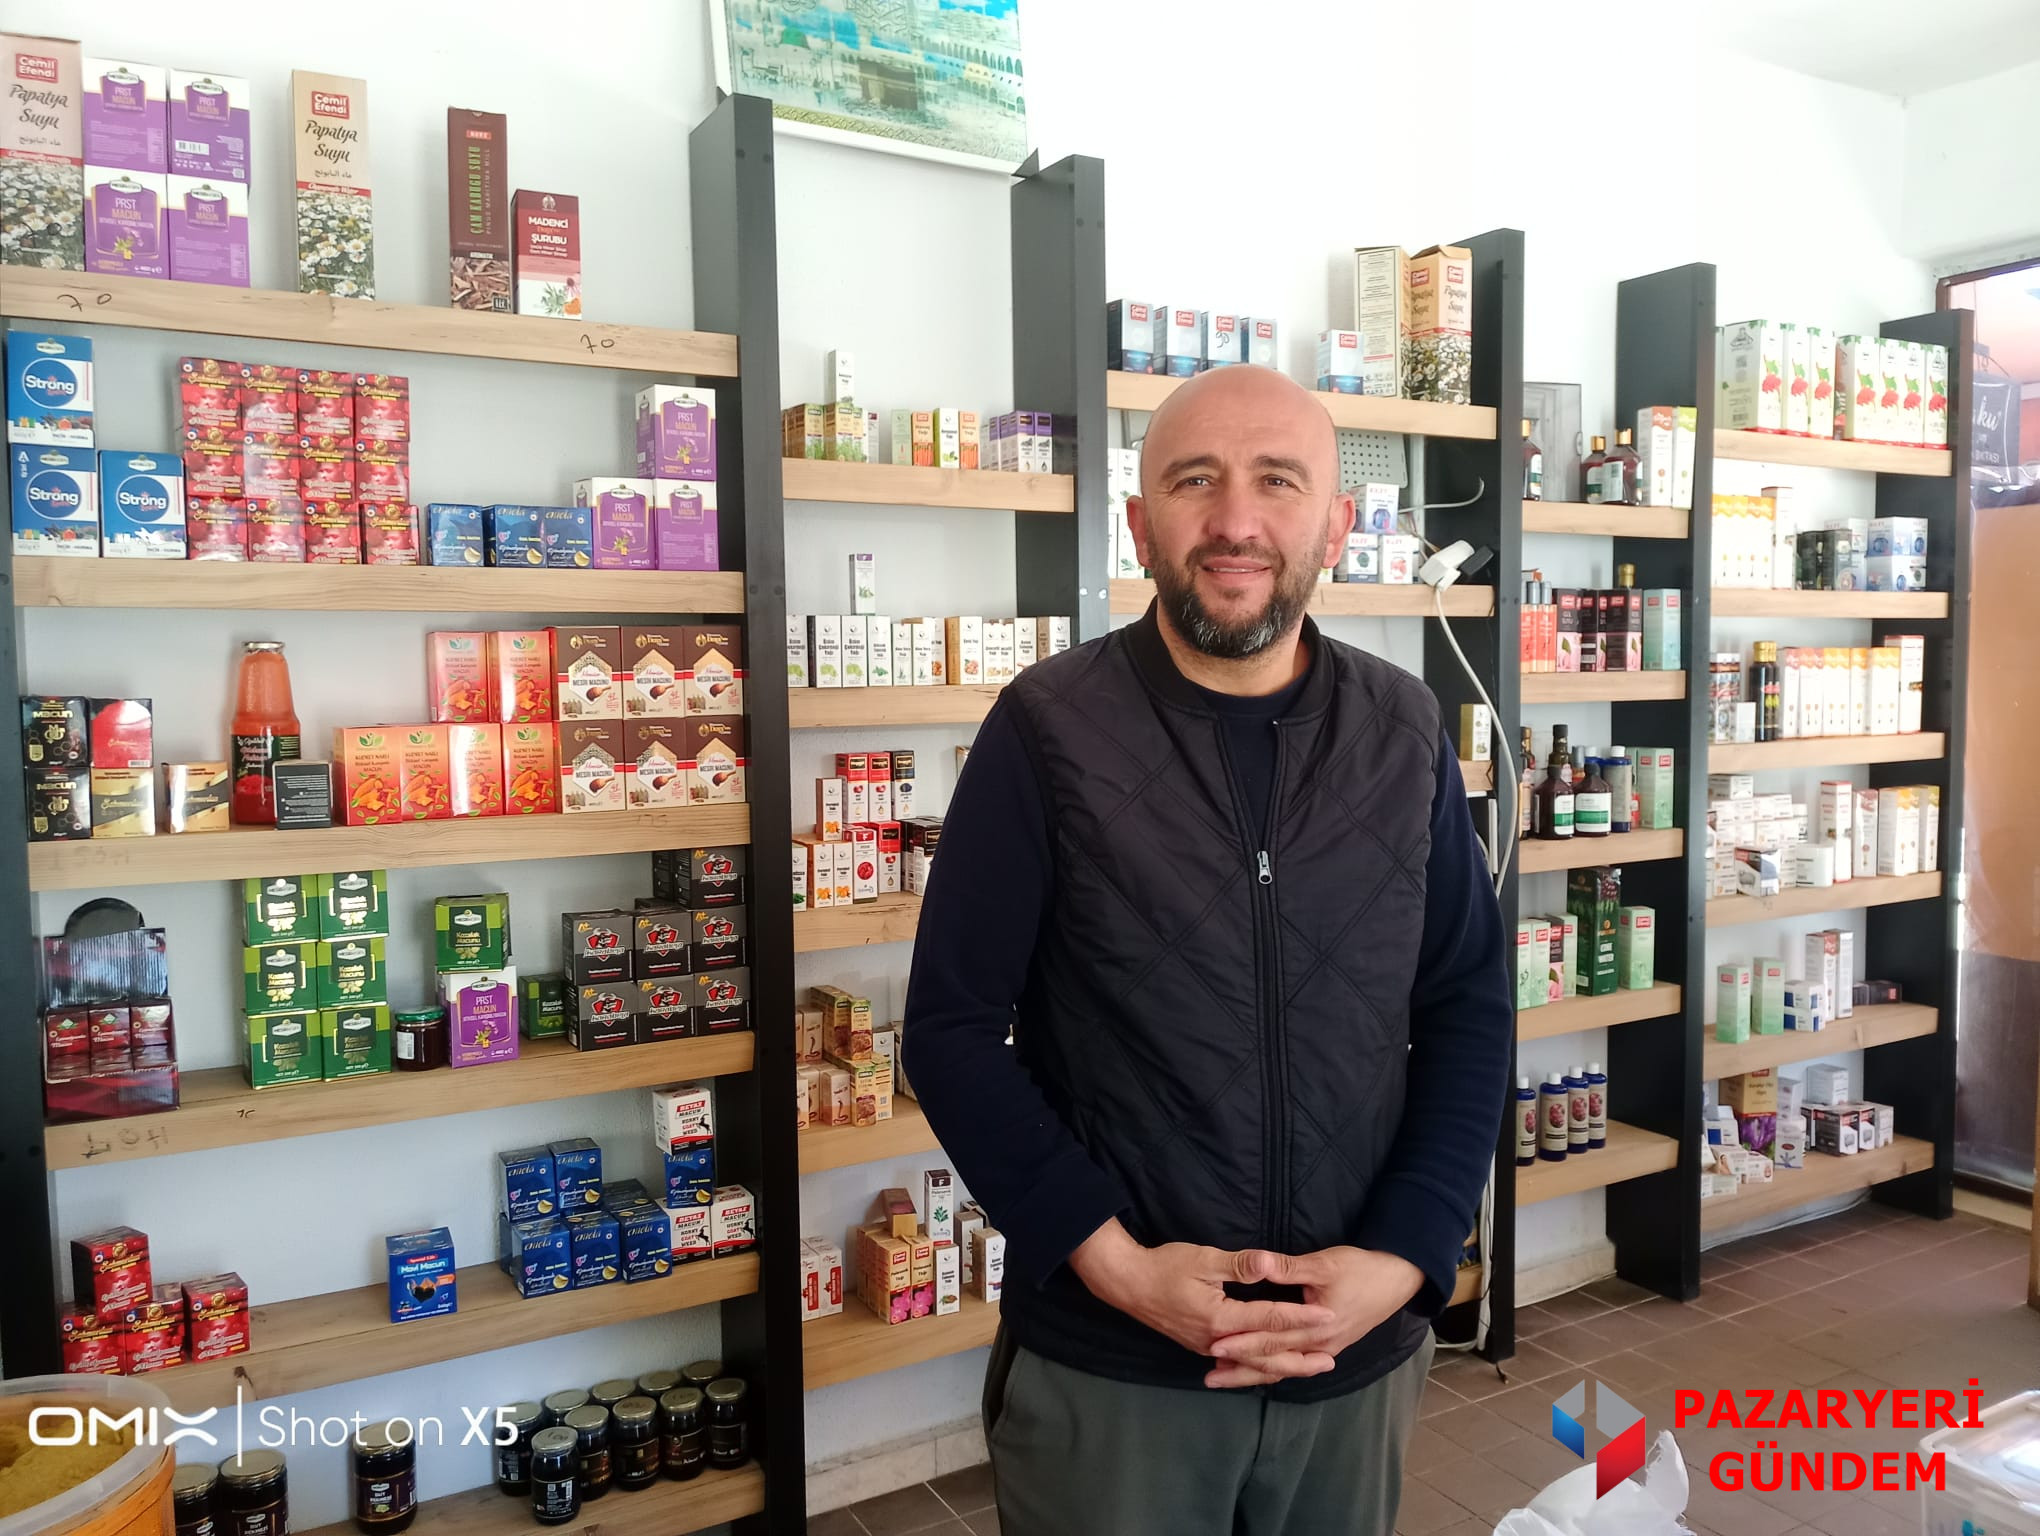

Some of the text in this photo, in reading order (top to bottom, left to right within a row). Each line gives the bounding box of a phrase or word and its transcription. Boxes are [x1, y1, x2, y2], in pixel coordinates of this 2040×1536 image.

[19, 56, 55, 69] Cemil
[19, 65, 55, 78] Efendi
[9, 83, 69, 108] Papatya
[314, 94, 346, 106] Cemil
[314, 103, 346, 114] Efendi
[19, 108, 60, 130] Suyu
[305, 120, 358, 143] Papatya
[314, 144, 350, 164] Suyu
[531, 233, 568, 246] ŞURUBU
[25, 374, 75, 394] Strong
[29, 487, 79, 505] Strong
[119, 491, 167, 510] Strong
[476, 995, 493, 1005] PRST
[420, 1261, 445, 1271] Macun
